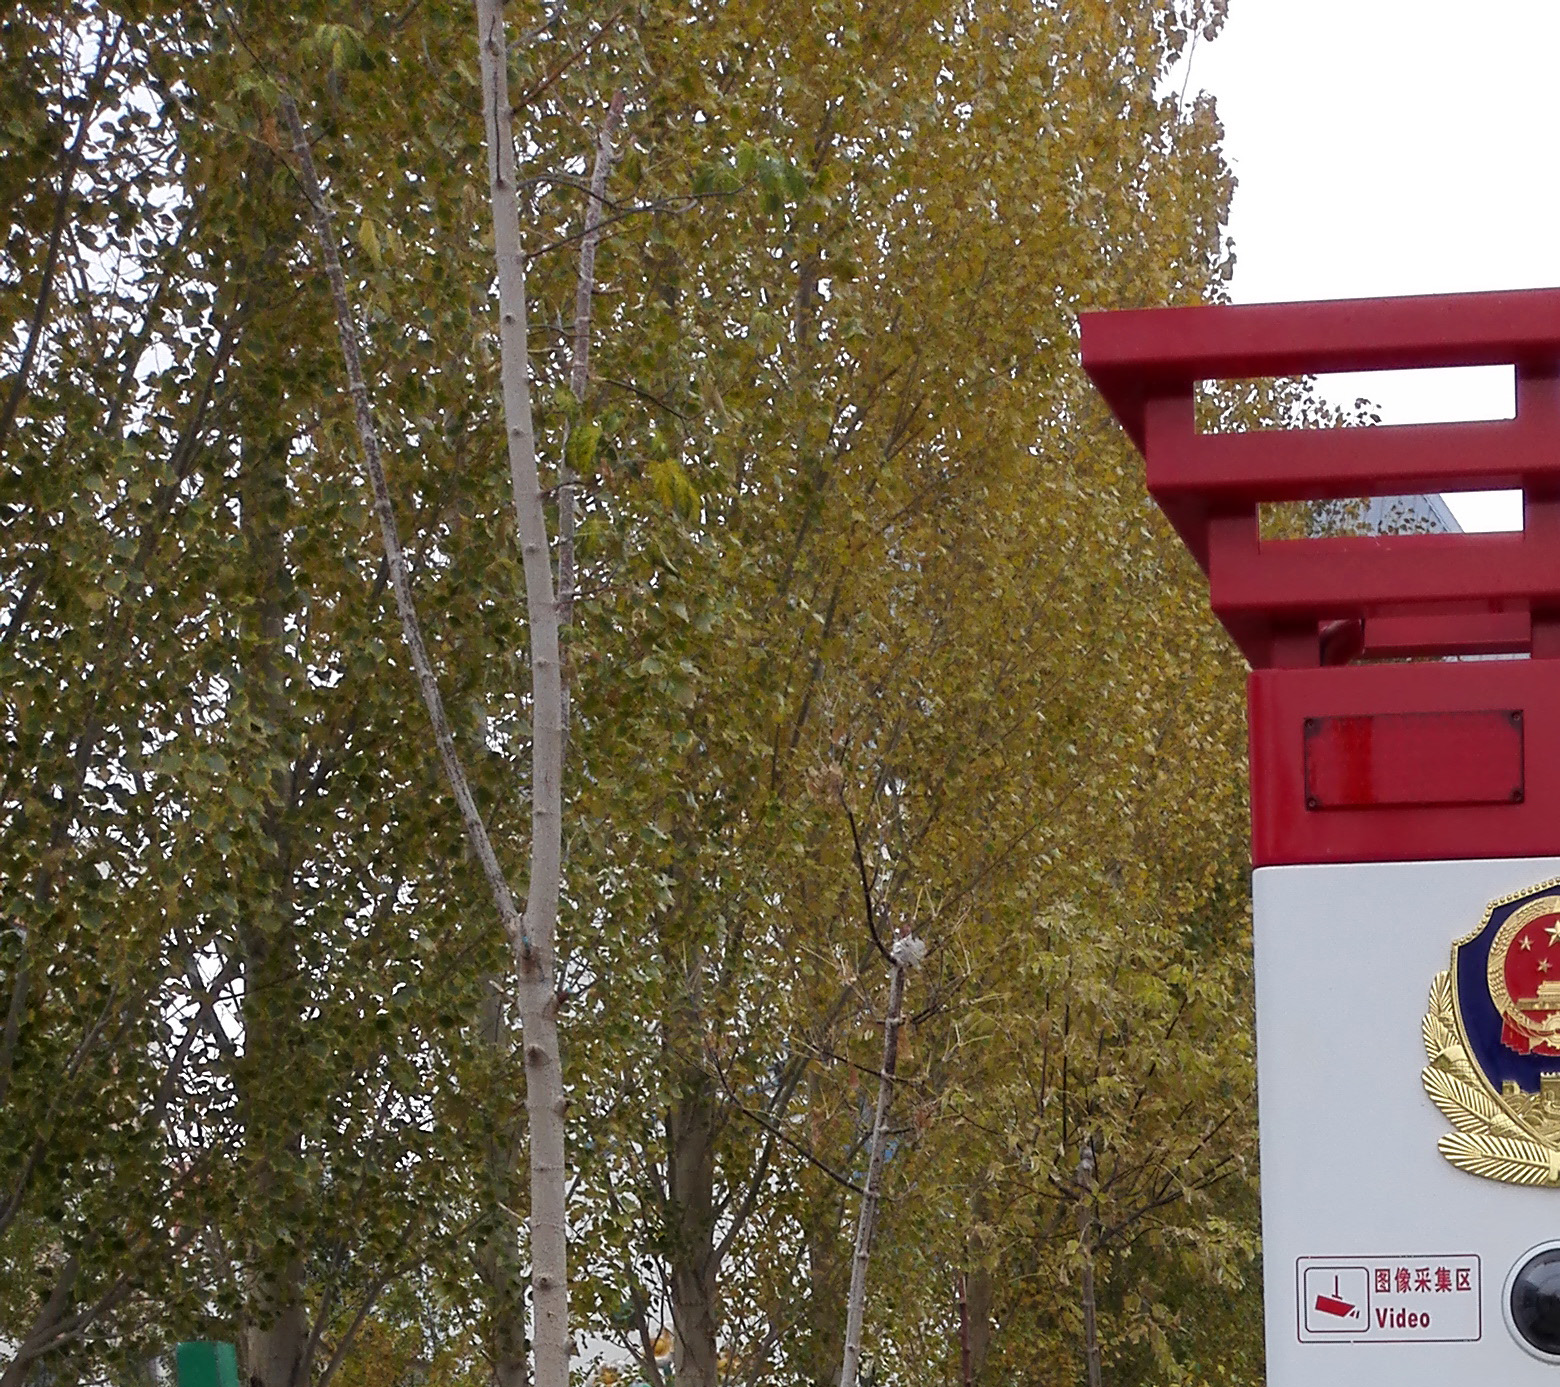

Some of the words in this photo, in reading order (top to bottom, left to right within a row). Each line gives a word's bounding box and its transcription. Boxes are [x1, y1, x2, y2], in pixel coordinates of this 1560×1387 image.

[1373, 1267, 1472, 1295] 图像采集区
[1375, 1307, 1431, 1329] Video
